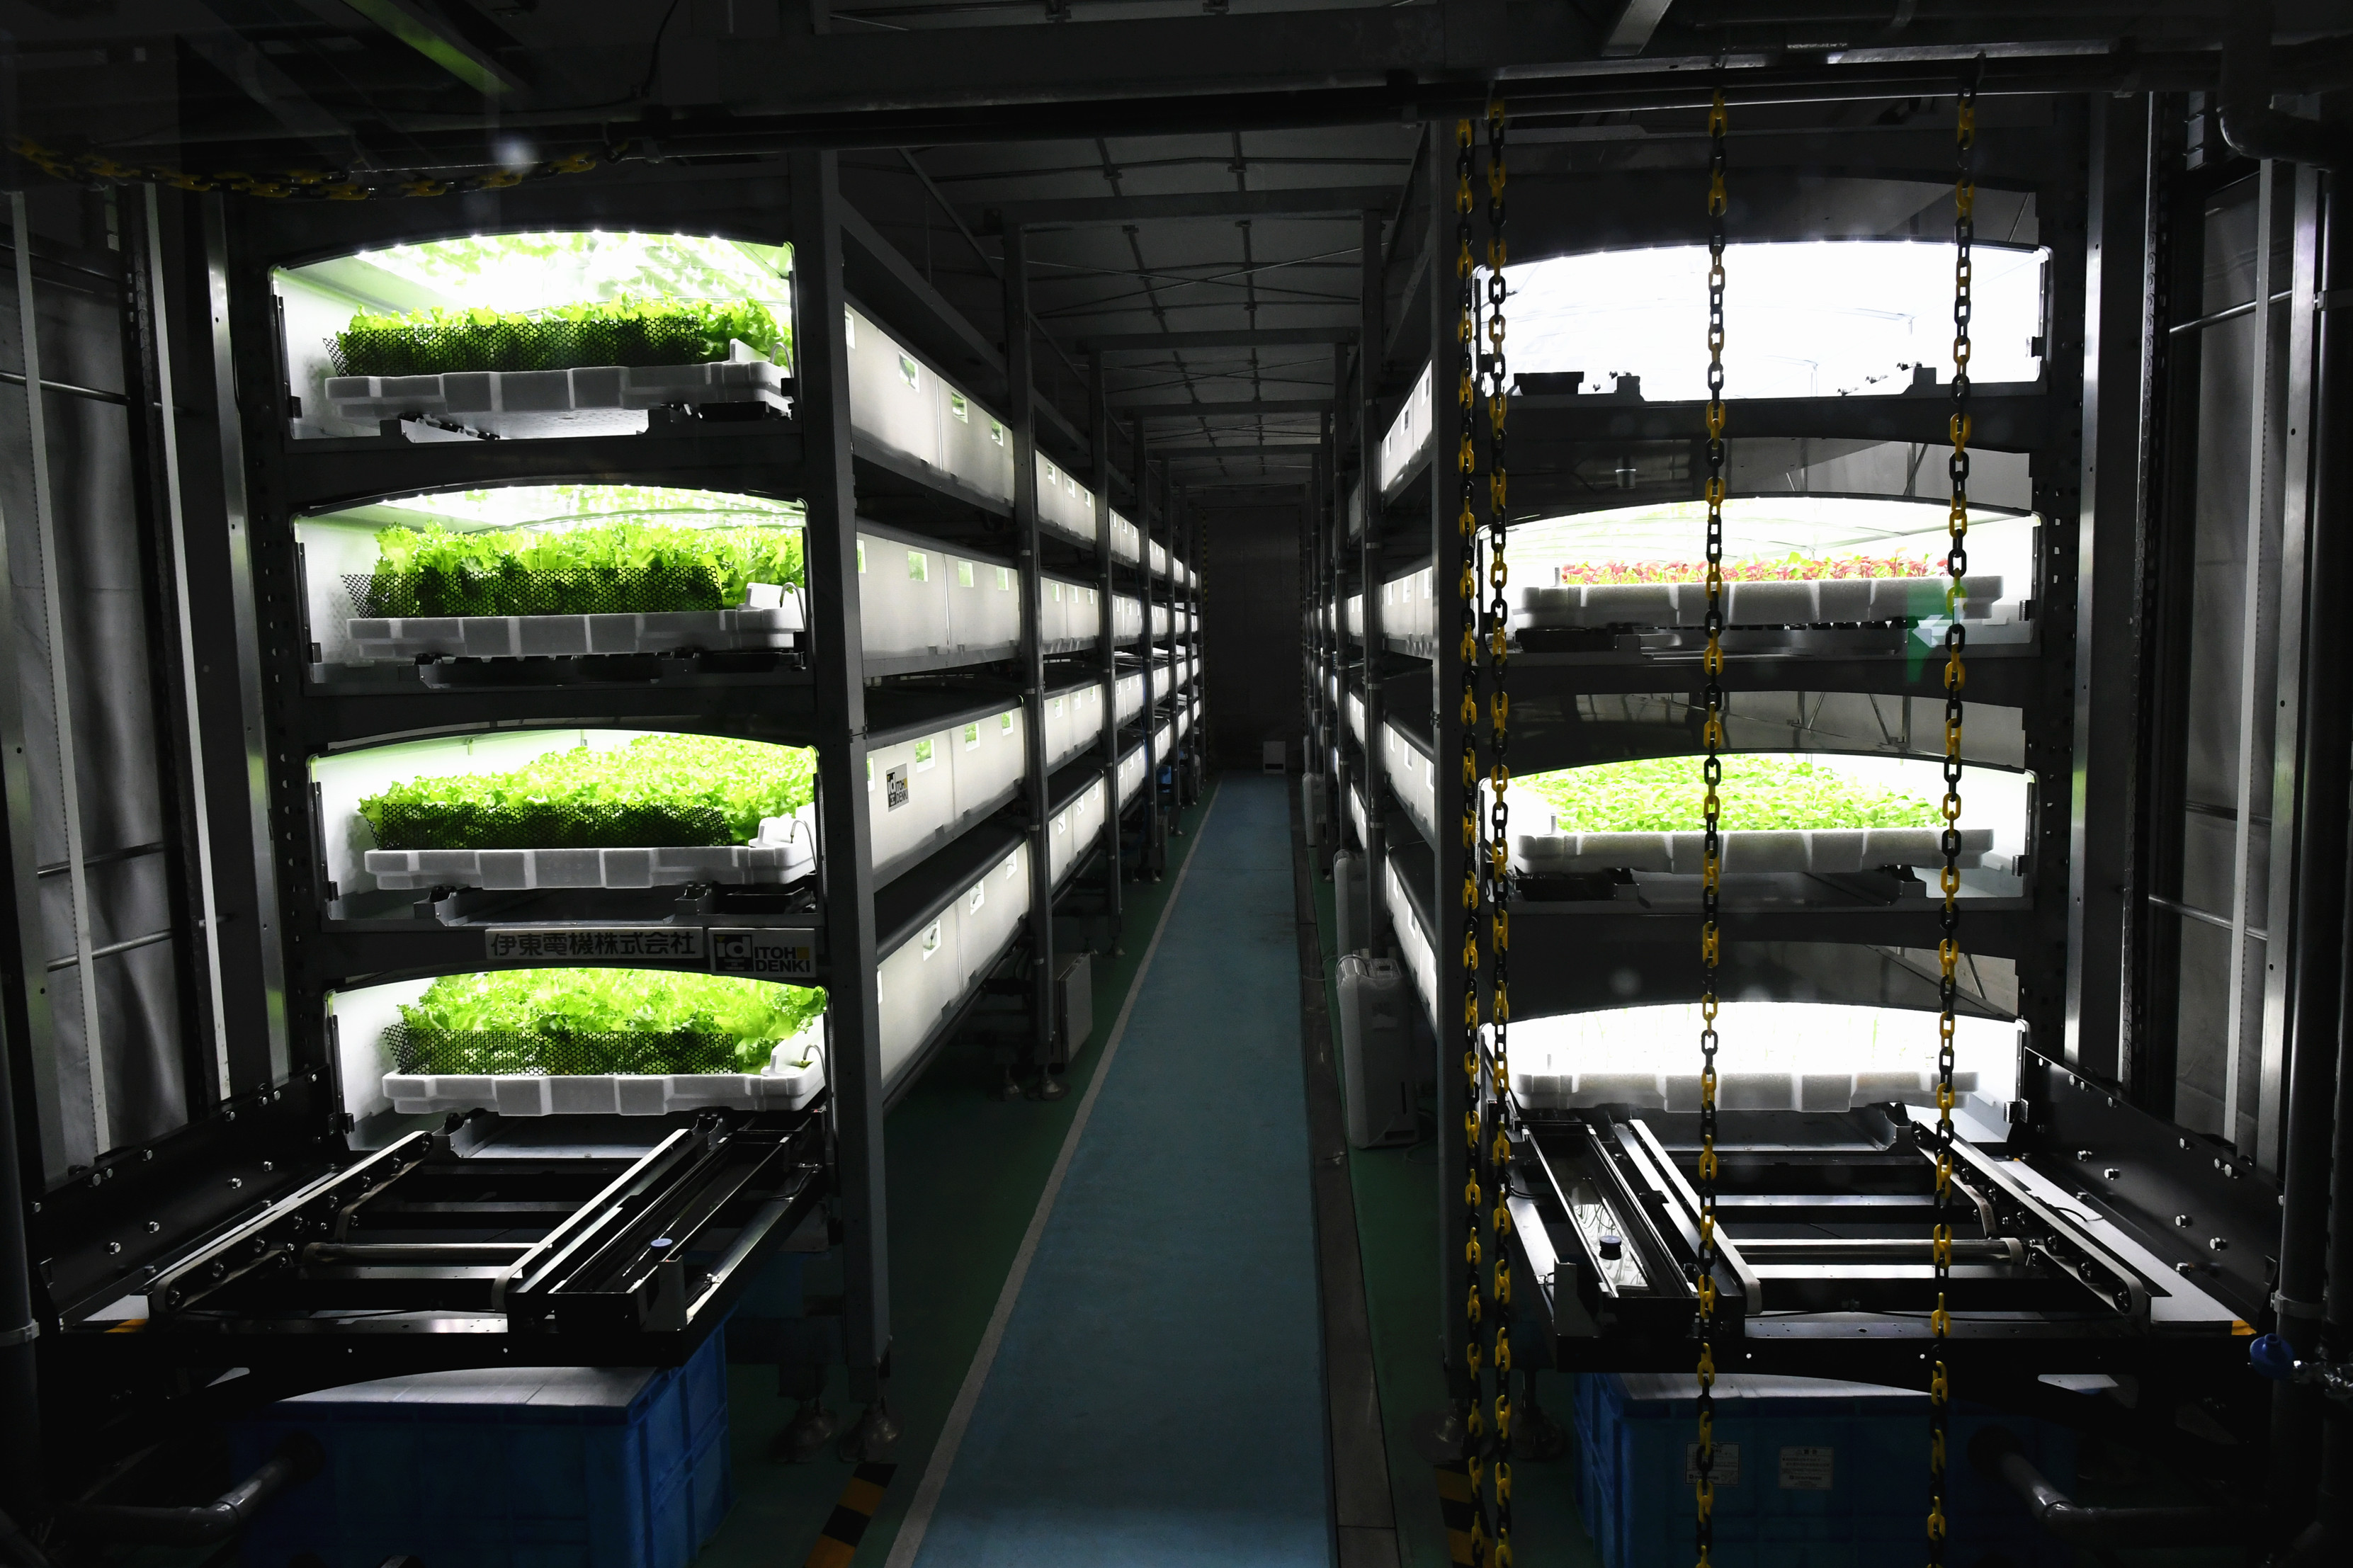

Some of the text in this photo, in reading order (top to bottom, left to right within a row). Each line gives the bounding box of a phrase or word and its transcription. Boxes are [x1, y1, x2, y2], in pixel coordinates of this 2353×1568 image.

[491, 931, 696, 956] 伊東電機株式会社
[754, 947, 796, 959] ITOH
[755, 960, 811, 972] DENKI
